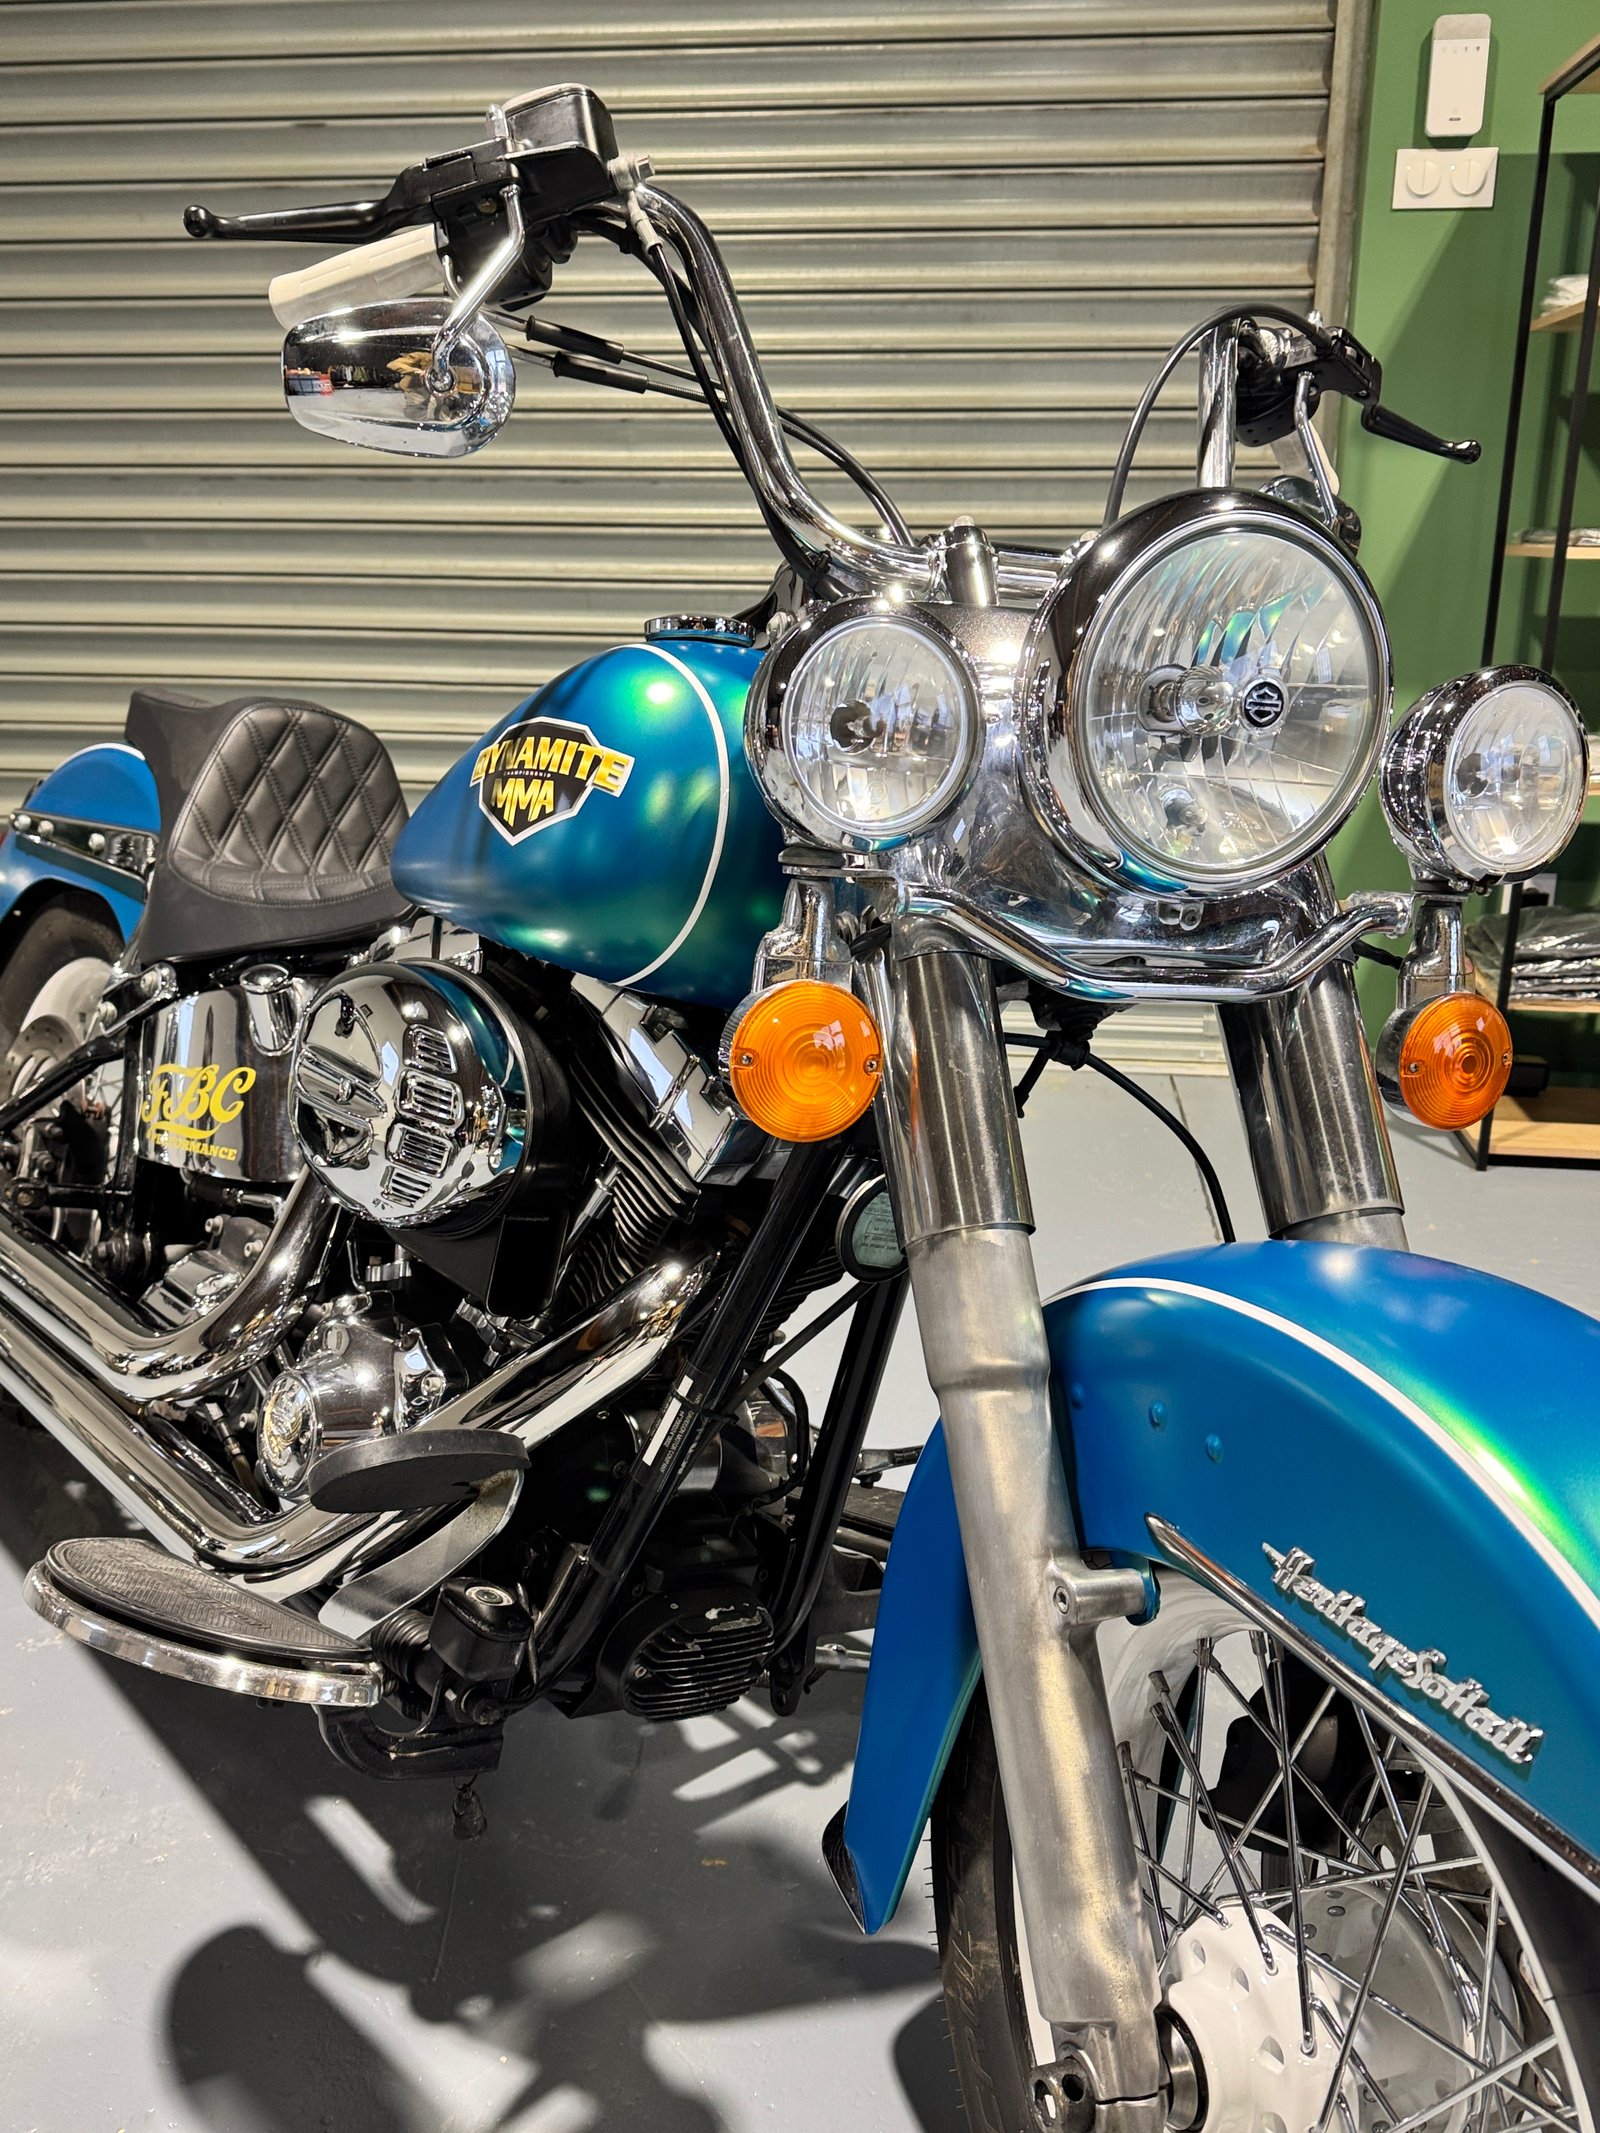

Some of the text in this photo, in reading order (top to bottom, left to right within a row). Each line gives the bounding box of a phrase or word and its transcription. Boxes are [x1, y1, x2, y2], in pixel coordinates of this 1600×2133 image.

[472, 736, 631, 792] DYNAMITE
[503, 769, 552, 778] CHAMPIONSHIP
[491, 778, 555, 827] MMA
[141, 1063, 257, 1124] FBC
[148, 1134, 238, 1161] PEORMANCE
[659, 1448, 676, 1474] COMPANY
[1261, 1542, 1544, 1764] Heritage Softail
